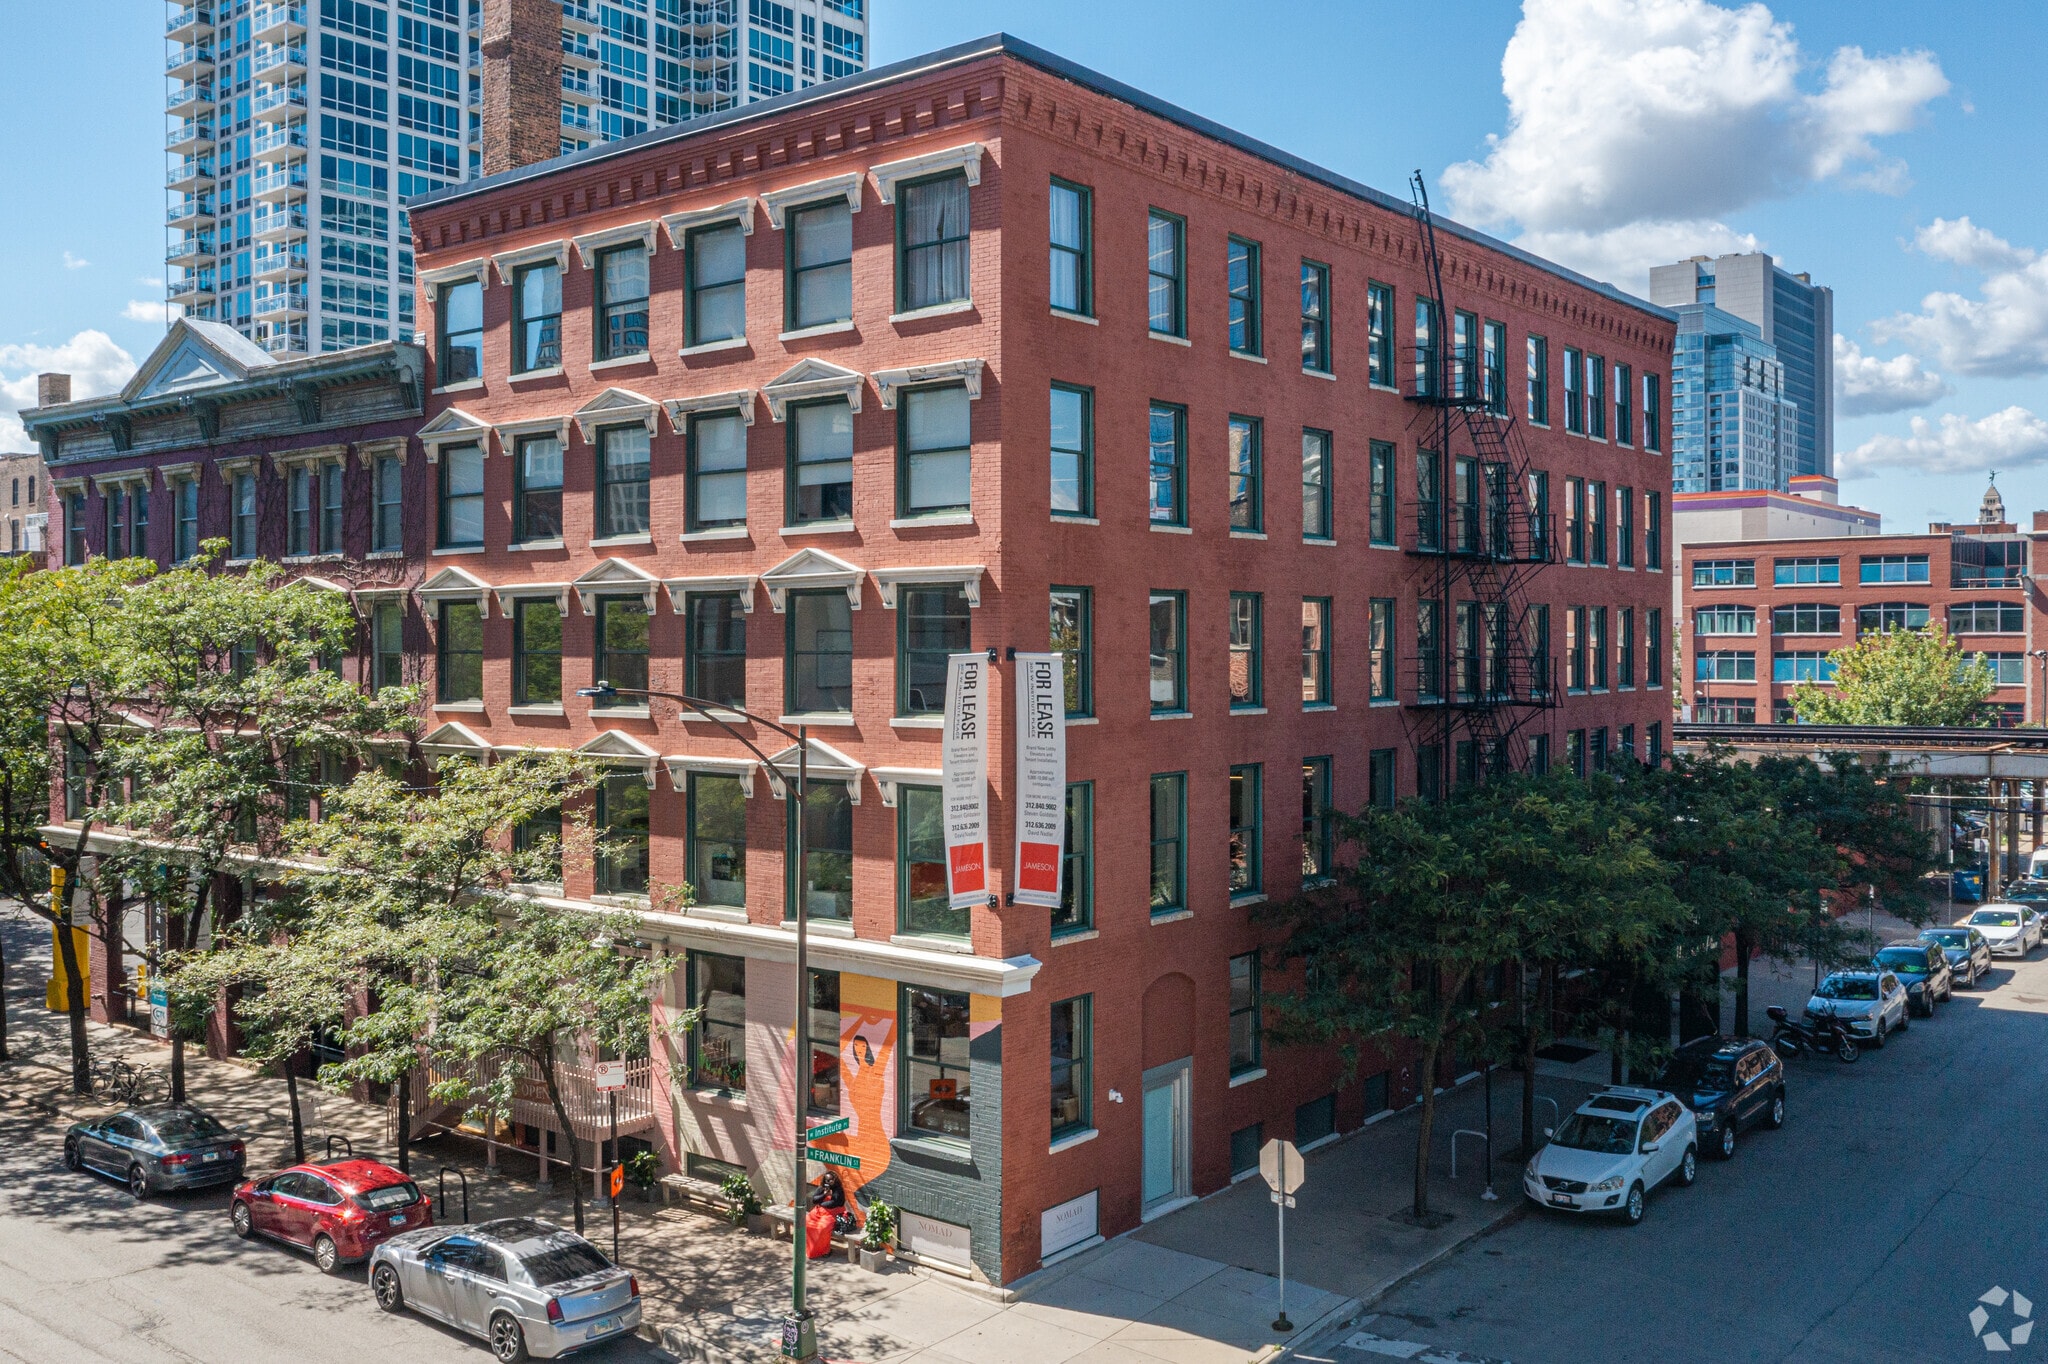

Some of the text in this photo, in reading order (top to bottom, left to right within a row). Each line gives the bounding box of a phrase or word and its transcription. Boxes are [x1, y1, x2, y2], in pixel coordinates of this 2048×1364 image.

[961, 662, 978, 740] FOR LEASE
[1035, 662, 1053, 739] FOR LEASE
[1025, 802, 1057, 810] 312.840.9002
[1025, 821, 1056, 830] 312.636.2009
[954, 862, 981, 874] JAMESON
[1024, 862, 1054, 872] JAMESON
[815, 1123, 842, 1137] Institute
[814, 1150, 852, 1166] FRANKLIN
[1056, 1205, 1082, 1222] NOMAD
[919, 1221, 952, 1237] NOMAD
